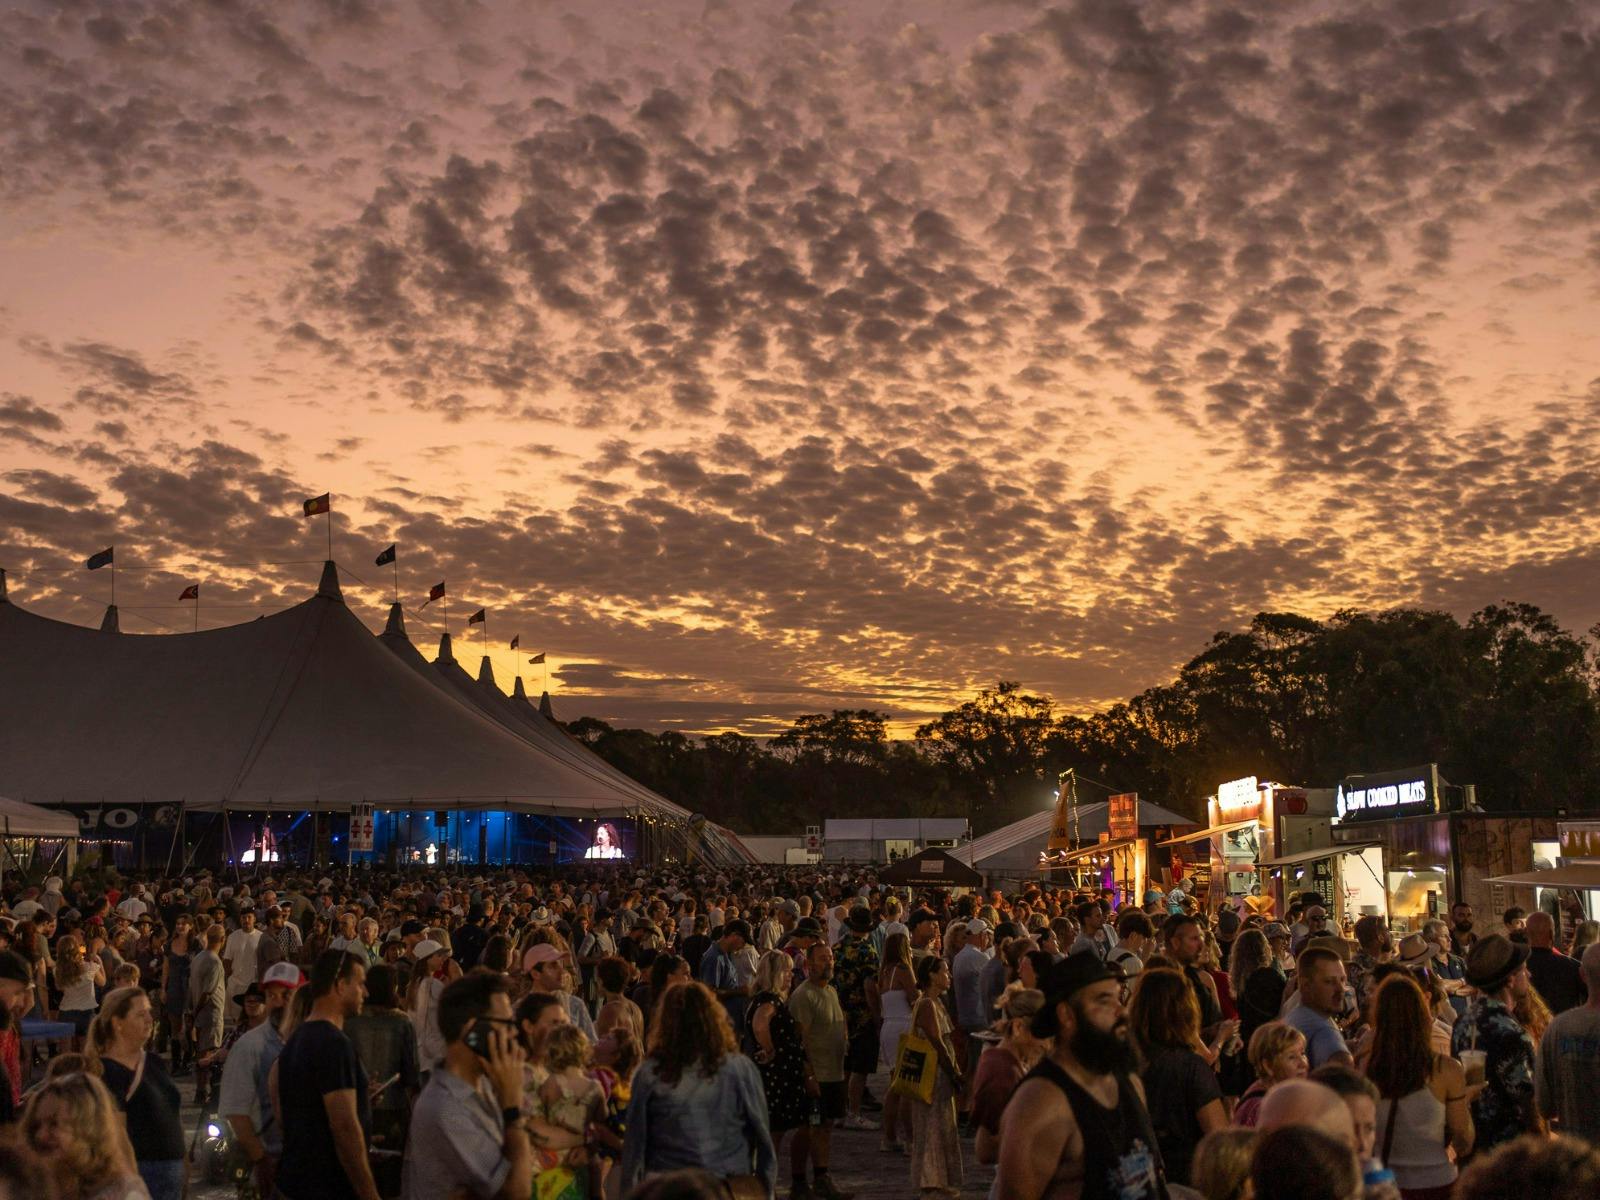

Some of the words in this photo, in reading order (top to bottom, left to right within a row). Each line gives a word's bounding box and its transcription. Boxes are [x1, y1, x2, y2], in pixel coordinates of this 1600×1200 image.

[1367, 785, 1398, 808] COOKED
[1398, 780, 1426, 804] MEATS
[79, 808, 138, 829] JO
[1492, 884, 1505, 916] FRIE
